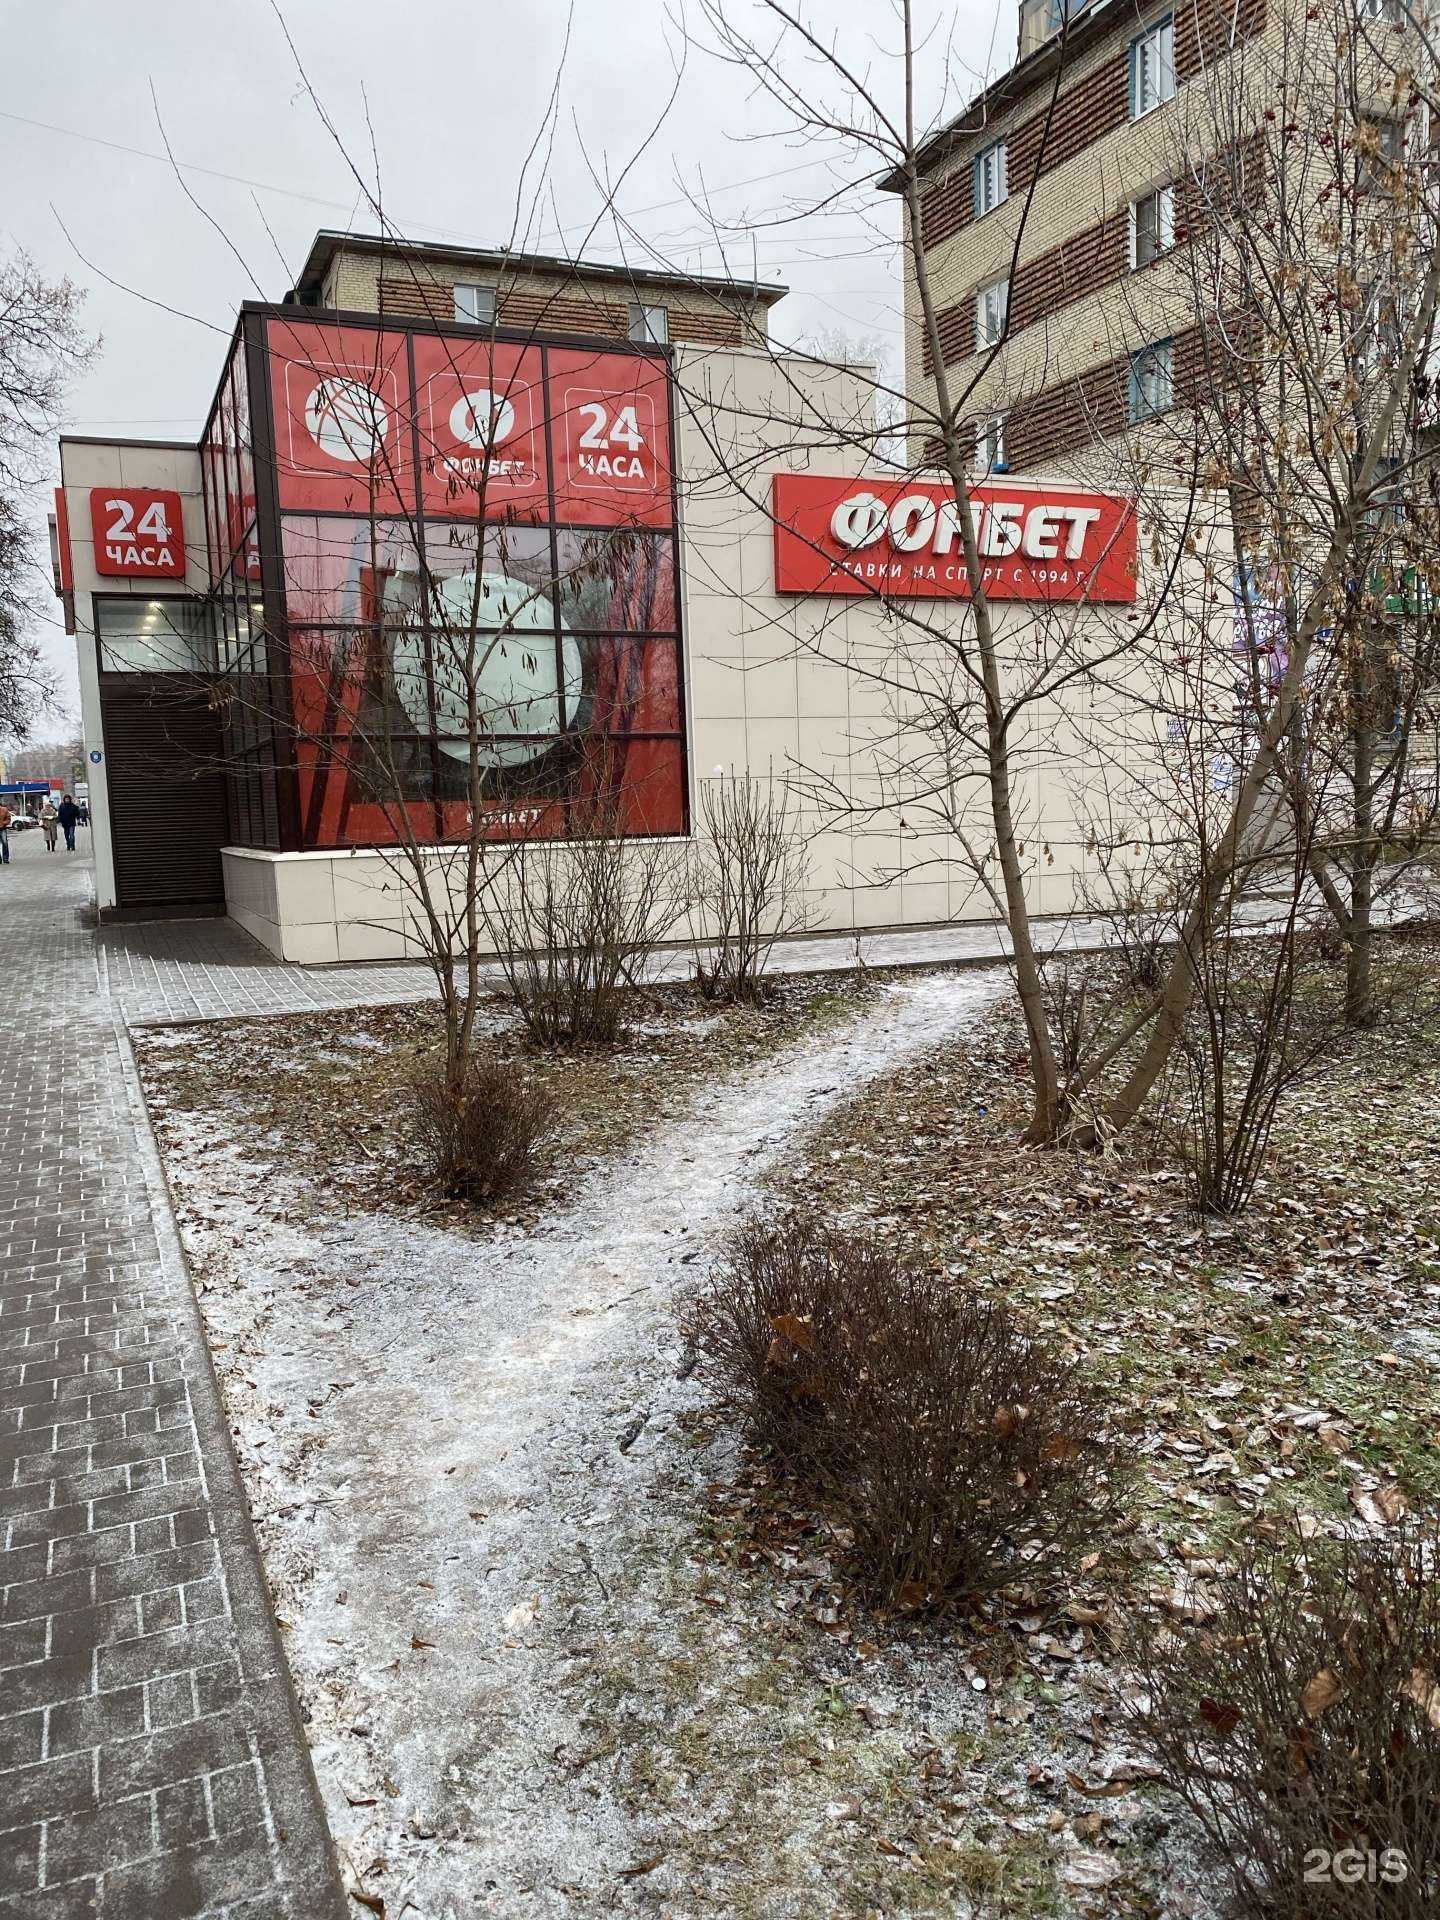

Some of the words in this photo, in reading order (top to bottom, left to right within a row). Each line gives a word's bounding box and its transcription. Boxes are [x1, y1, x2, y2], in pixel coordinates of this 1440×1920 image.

[579, 403, 644, 451] 24
[578, 453, 645, 479] ЧАСА
[105, 499, 172, 543] 24
[831, 492, 1101, 560] ФОНБЕТ
[106, 545, 175, 567] ЧАСА
[914, 565, 936, 580] НА
[945, 566, 1003, 581] СПРТ
